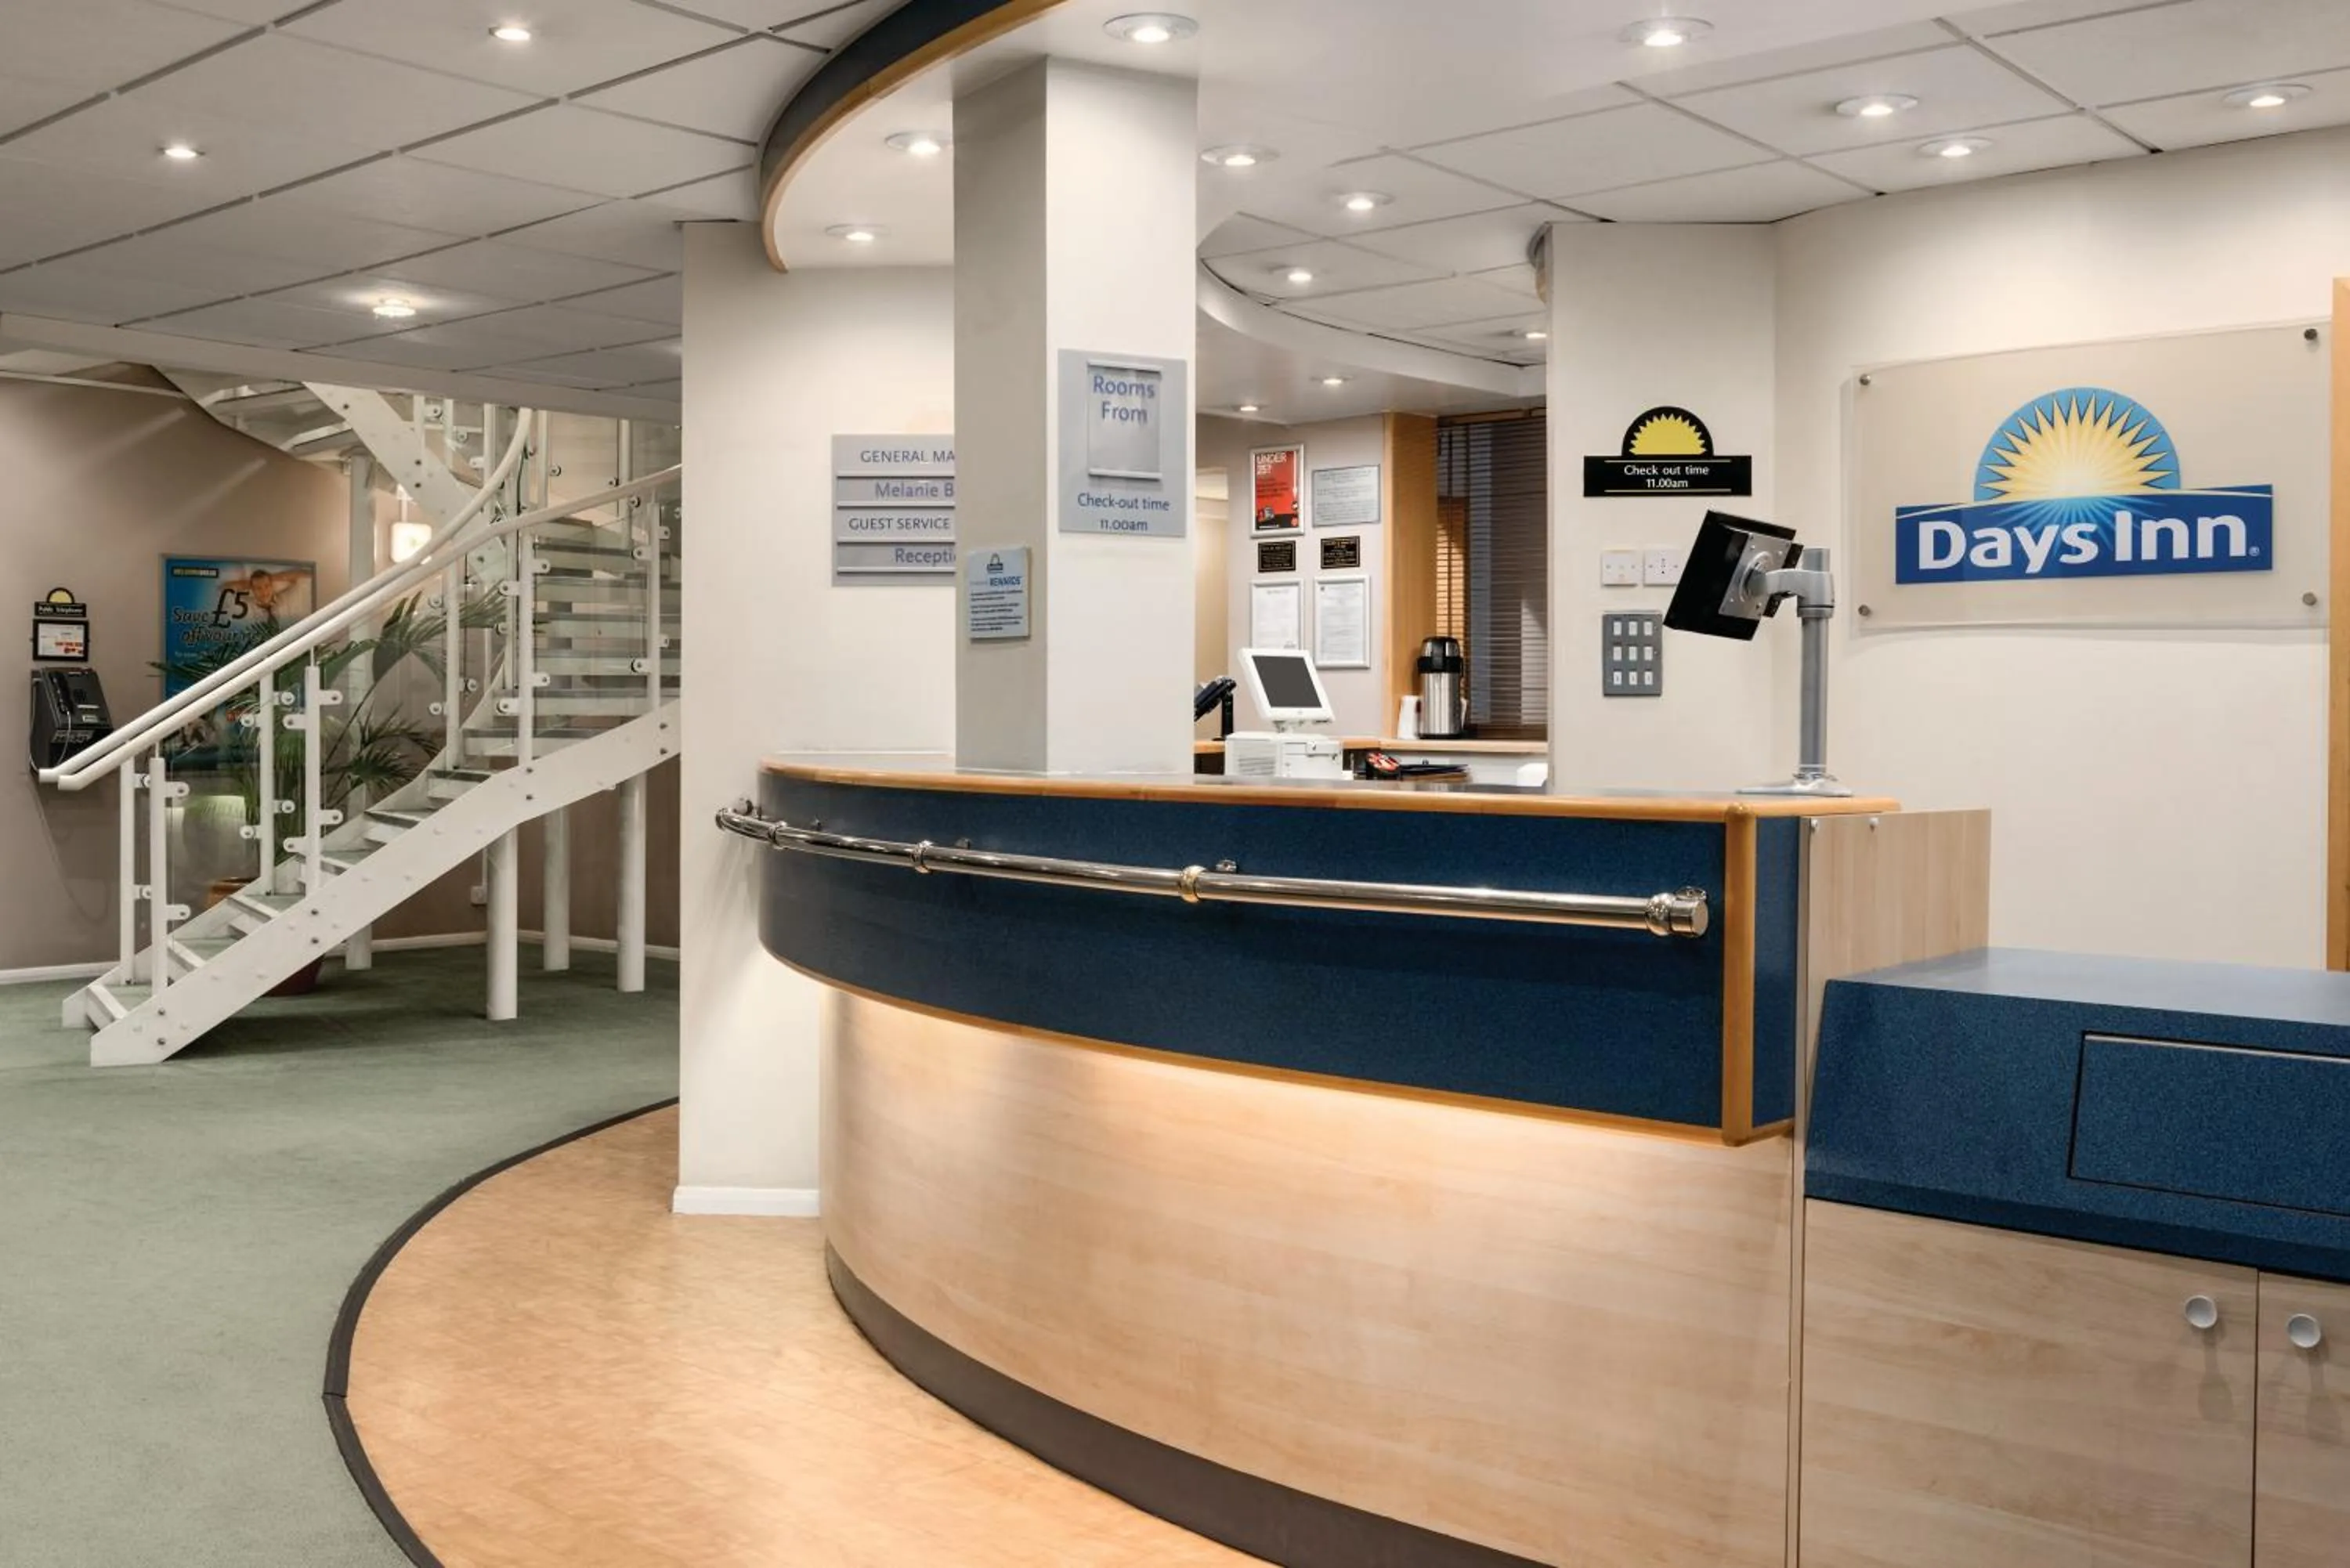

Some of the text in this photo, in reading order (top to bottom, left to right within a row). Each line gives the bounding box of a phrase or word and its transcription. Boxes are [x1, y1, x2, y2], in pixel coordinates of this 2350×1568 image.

[1093, 375, 1155, 399] Rooms
[1101, 401, 1148, 424] From
[860, 450, 928, 463] GENERAL
[1624, 464, 1710, 475] Check out time
[875, 482, 938, 498] Melanie
[1646, 478, 1689, 488] 11.00am
[1077, 492, 1170, 511] Check-out time
[848, 517, 950, 530] GUEST SERVICE
[1100, 518, 1148, 531] 11.00am
[1918, 510, 2247, 574] Days Inn
[895, 547, 956, 567] Recepti
[173, 588, 250, 629] Save £5
